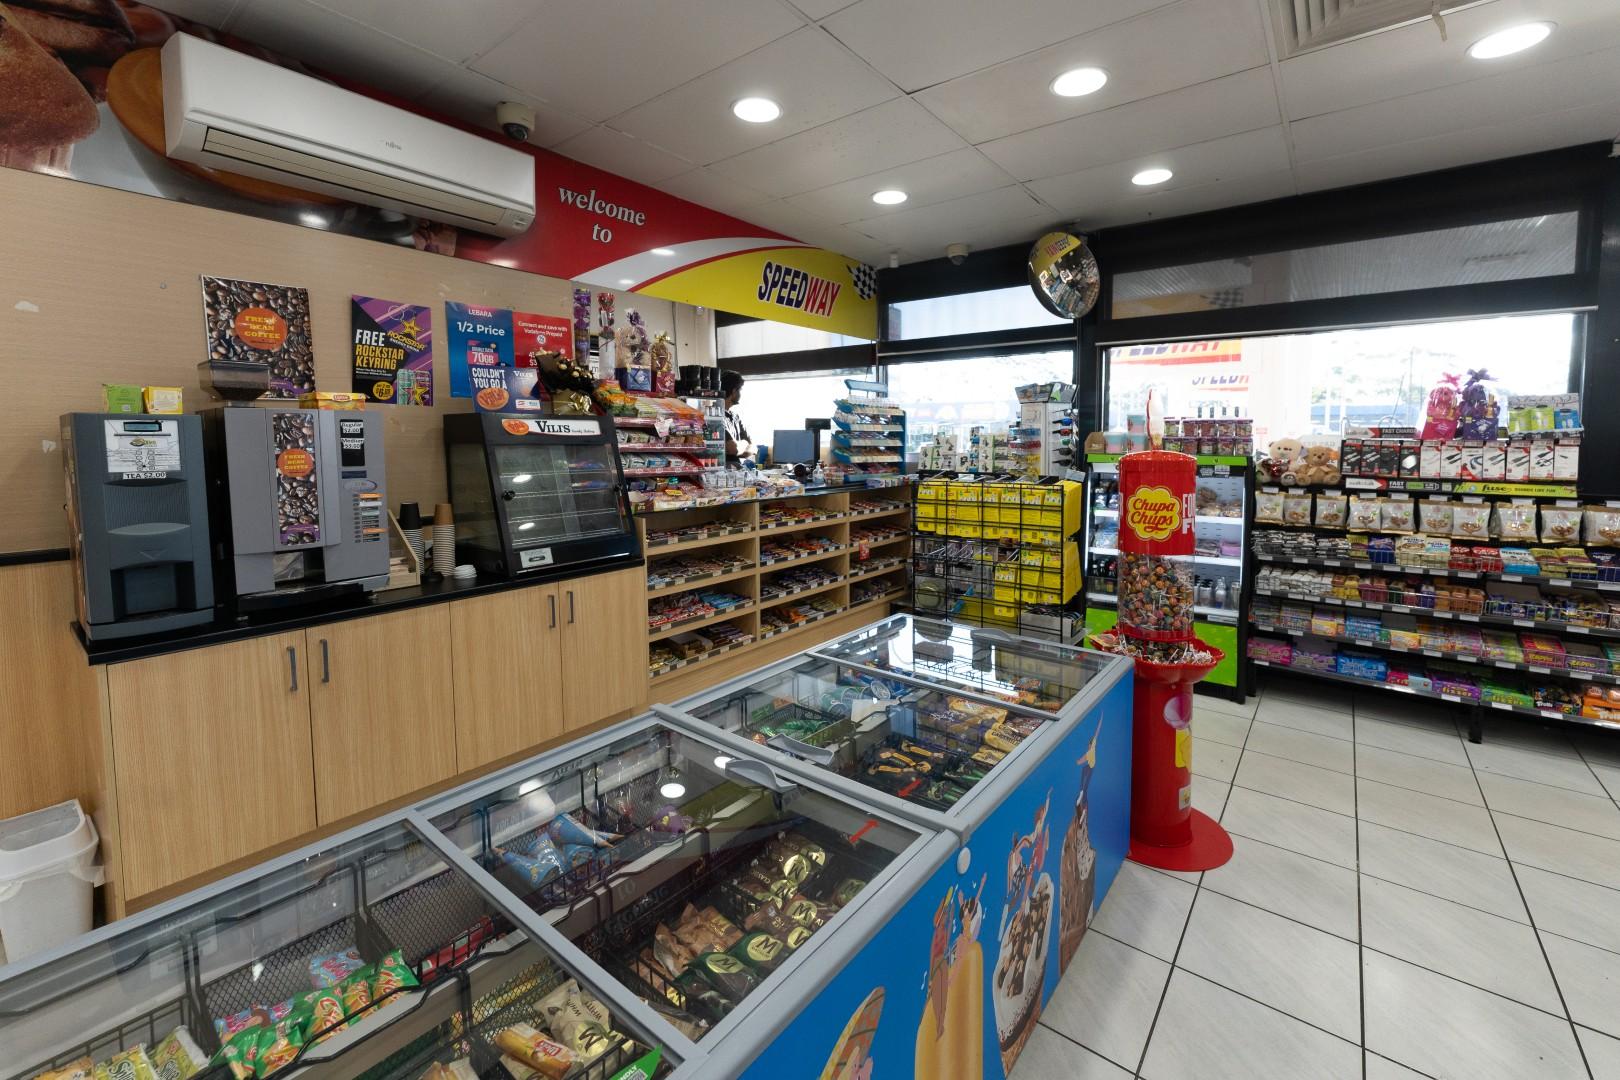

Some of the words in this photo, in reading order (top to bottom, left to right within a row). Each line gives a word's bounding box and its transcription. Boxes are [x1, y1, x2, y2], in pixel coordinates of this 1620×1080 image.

[558, 186, 646, 226] welcome
[592, 223, 613, 244] to
[758, 260, 841, 317] SPEEDWAY
[468, 308, 492, 318] LEBARA
[355, 328, 386, 347] FREE
[457, 322, 474, 333] 1/2
[477, 324, 505, 336] Price
[387, 330, 426, 351] ROCKSTAR
[355, 344, 404, 360] ROCKSTAR
[355, 355, 396, 370] KEYRING
[471, 367, 505, 379] COULDN'T
[472, 377, 489, 389] YOU
[143, 471, 165, 479] $2.00
[1132, 498, 1175, 515] Chupa
[1130, 510, 1173, 527] Chups
[756, 936, 778, 954] M
[716, 957, 738, 969] M
[578, 1026, 601, 1053] M
